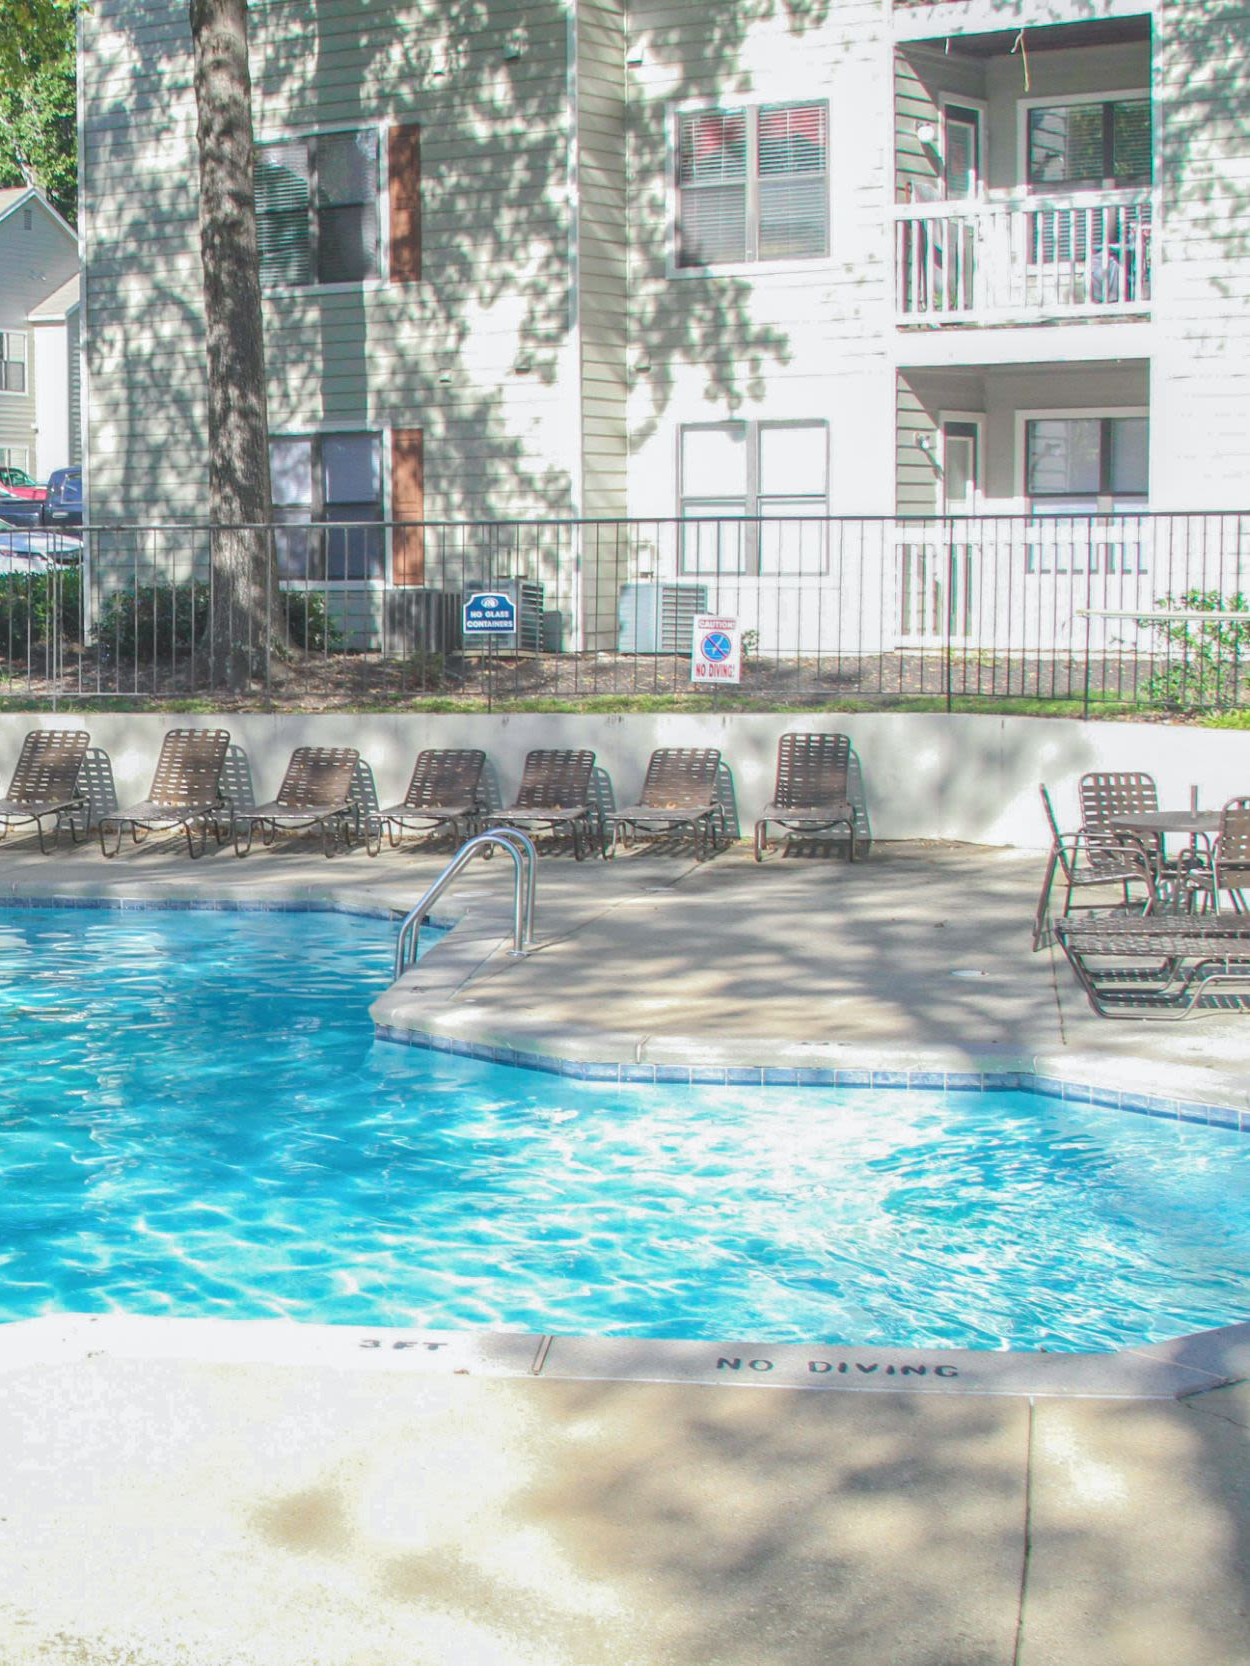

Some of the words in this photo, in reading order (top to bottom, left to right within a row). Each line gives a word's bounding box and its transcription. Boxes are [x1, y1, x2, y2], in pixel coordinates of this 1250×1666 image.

[470, 610, 483, 618] NO
[484, 610, 509, 618] GLASS
[466, 620, 513, 628] CONTAINERS
[695, 663, 706, 677] NO
[716, 1357, 774, 1372] NO
[808, 1360, 960, 1378] DIVING
